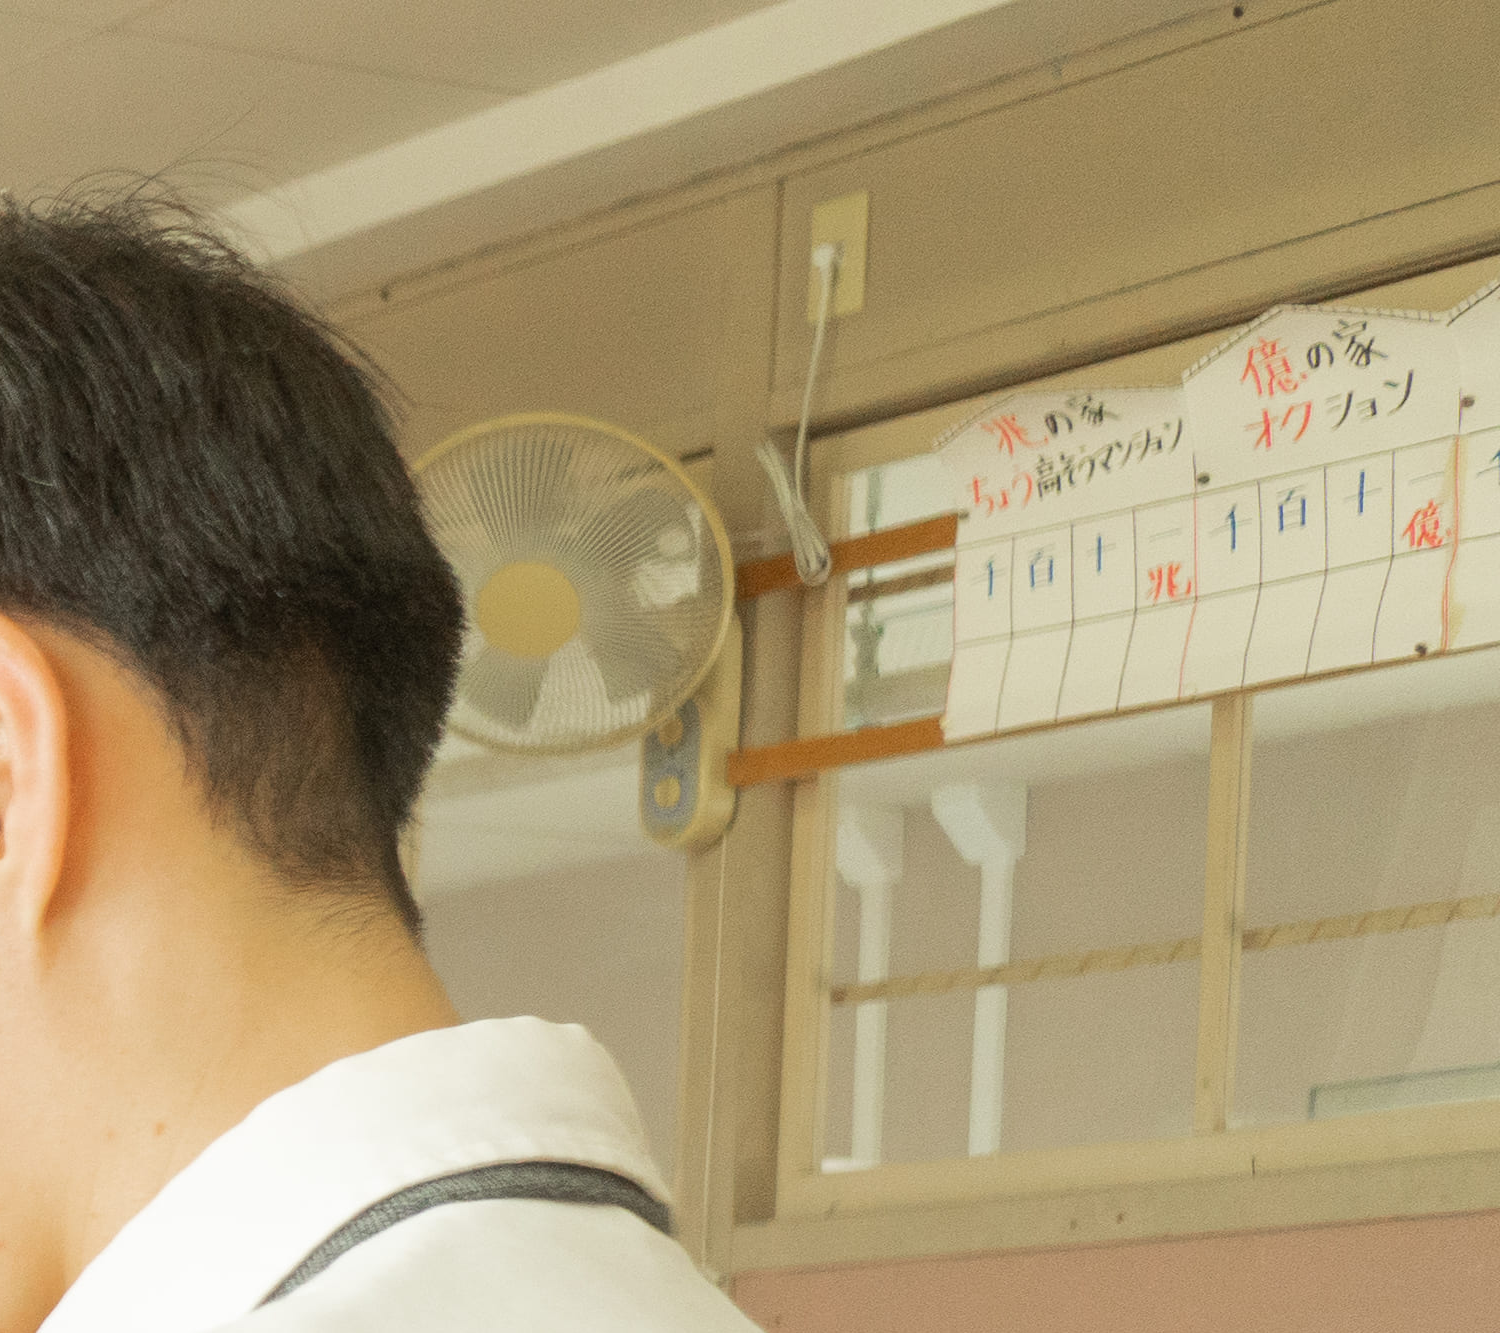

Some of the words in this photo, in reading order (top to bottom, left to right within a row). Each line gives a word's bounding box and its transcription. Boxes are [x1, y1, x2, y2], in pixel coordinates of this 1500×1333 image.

[1244, 369, 1414, 450] オクション
